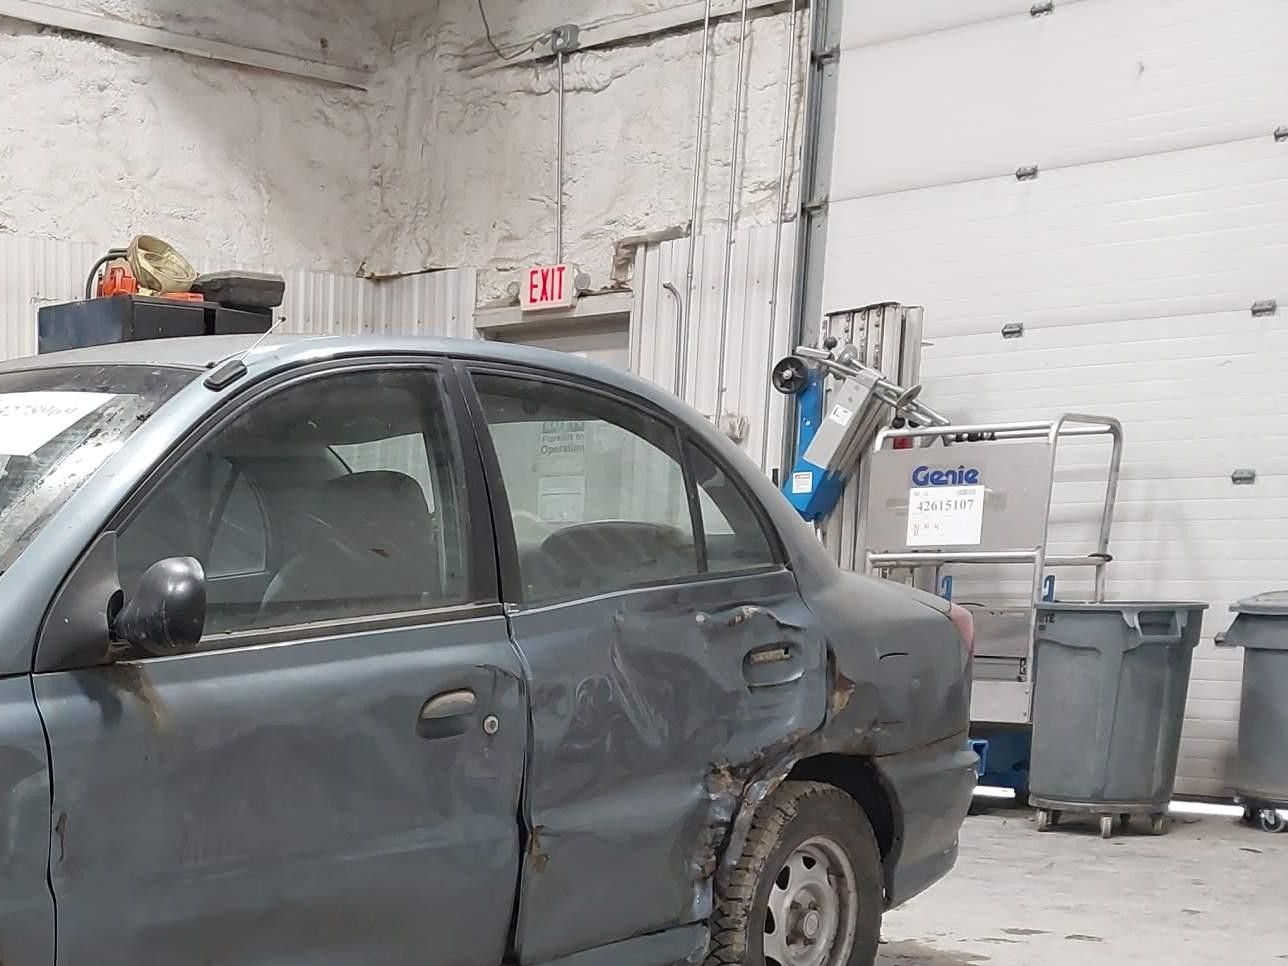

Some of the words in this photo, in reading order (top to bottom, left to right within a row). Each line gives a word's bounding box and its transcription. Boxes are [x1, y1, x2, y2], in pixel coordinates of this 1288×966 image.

[529, 266, 566, 304] EXIT
[540, 443, 585, 455] Operation
[912, 465, 980, 486] Genie
[916, 499, 975, 511] 42615107
